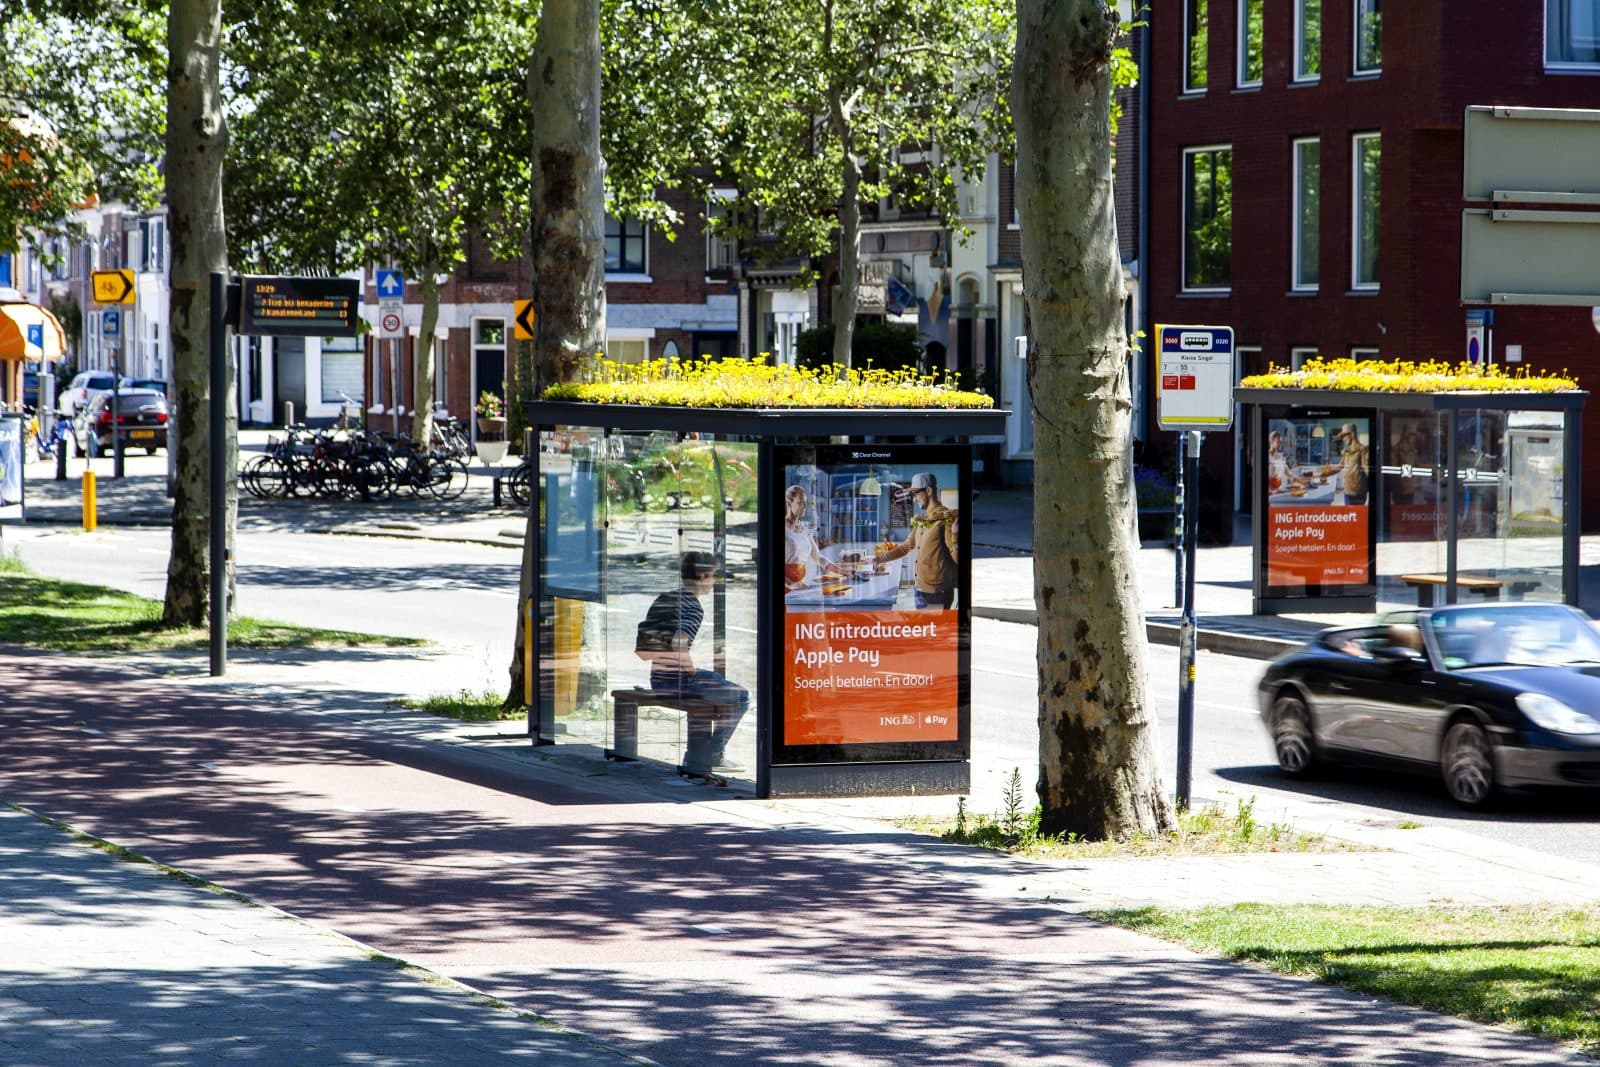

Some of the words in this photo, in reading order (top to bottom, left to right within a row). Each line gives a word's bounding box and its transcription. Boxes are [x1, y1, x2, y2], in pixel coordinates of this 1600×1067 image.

[31, 330, 39, 342] P
[1275, 513, 1293, 523] ING
[1295, 512, 1358, 523] introduceert
[1275, 527, 1304, 540] Apple
[1306, 527, 1325, 540] Pay
[1275, 544, 1298, 553] Soepel
[1327, 543, 1336, 551] En
[795, 623, 825, 640] ING
[830, 621, 937, 639] introduceert
[794, 647, 844, 669] Apple
[848, 646, 880, 668] Pay
[794, 675, 834, 692] Soepel
[836, 675, 884, 689] betalen.
[885, 674, 900, 687] En
[903, 673, 934, 687] door!
[880, 716, 901, 726] ING
[932, 715, 949, 726] Pay
